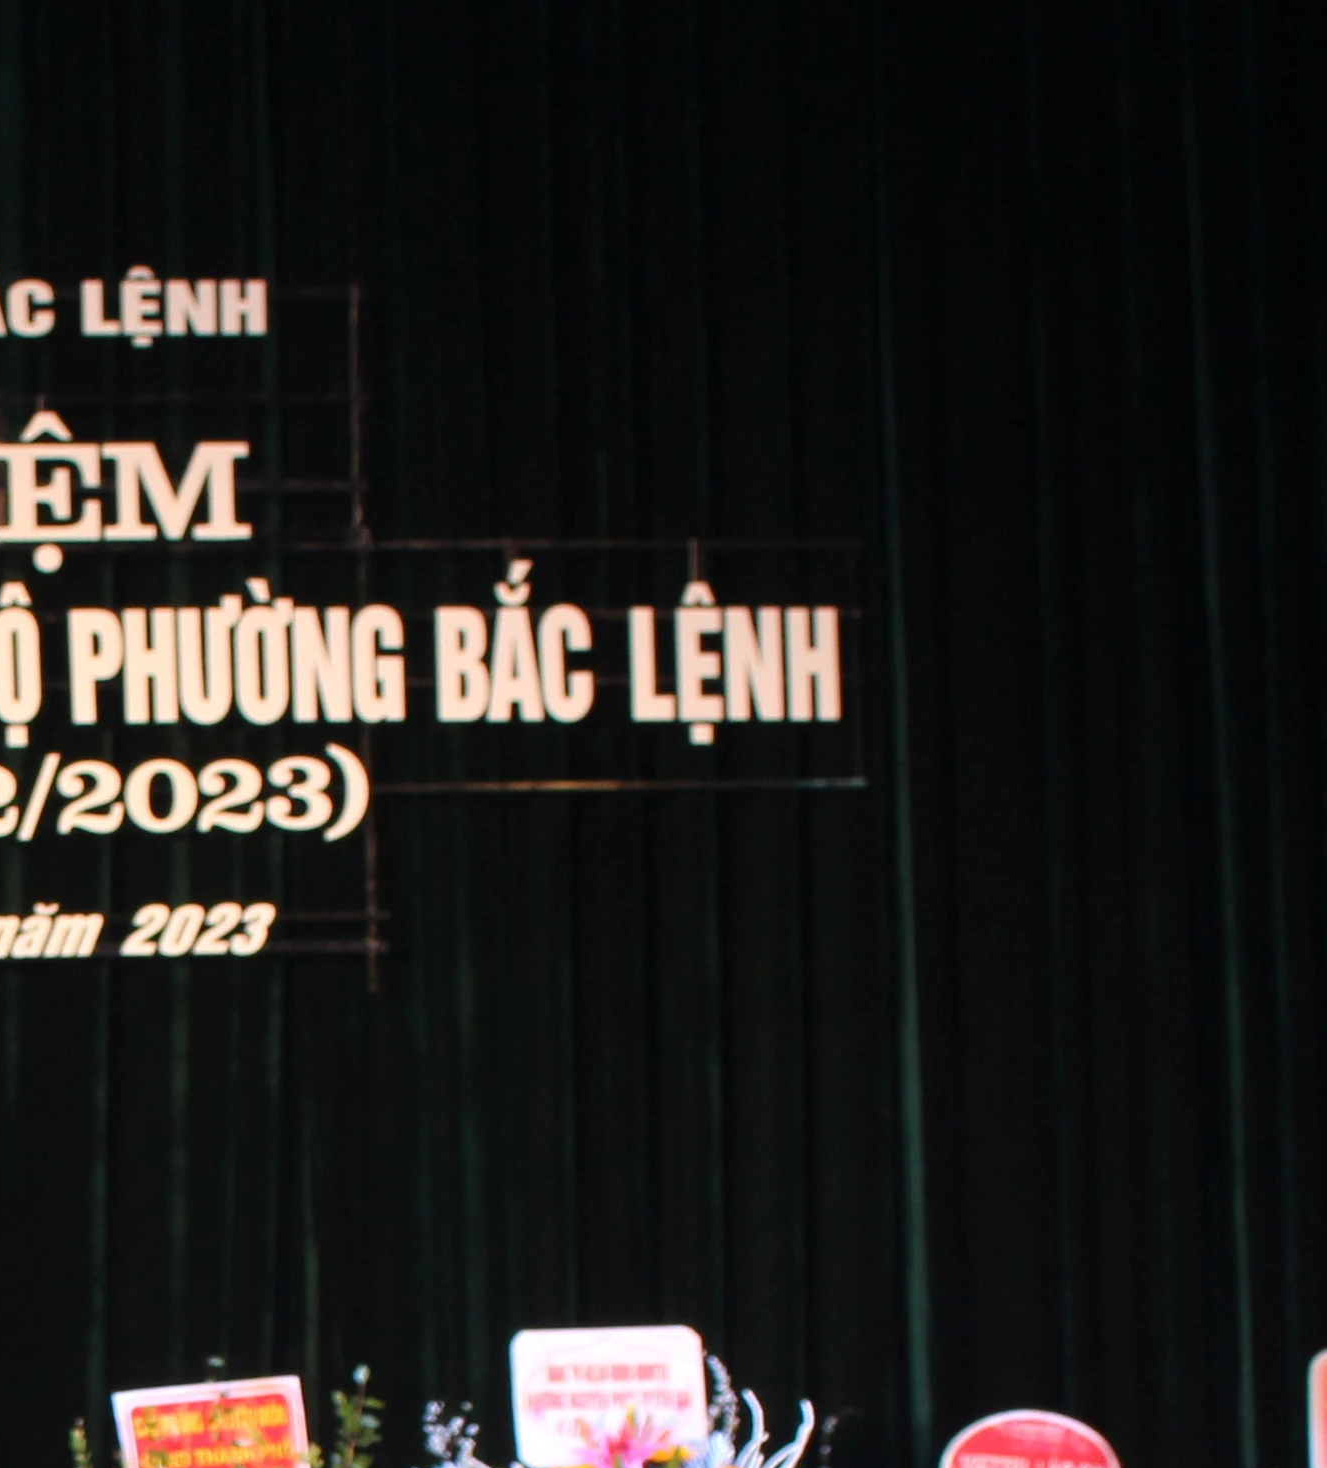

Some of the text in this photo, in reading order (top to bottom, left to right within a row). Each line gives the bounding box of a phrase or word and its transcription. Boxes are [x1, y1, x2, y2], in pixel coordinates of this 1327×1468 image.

[81, 265, 266, 348] LỆNH
[67, 577, 406, 725] PHƯỜNG
[434, 560, 594, 723] BẮC
[629, 581, 840, 746] LỆNH
[118, 902, 277, 957] 2023
